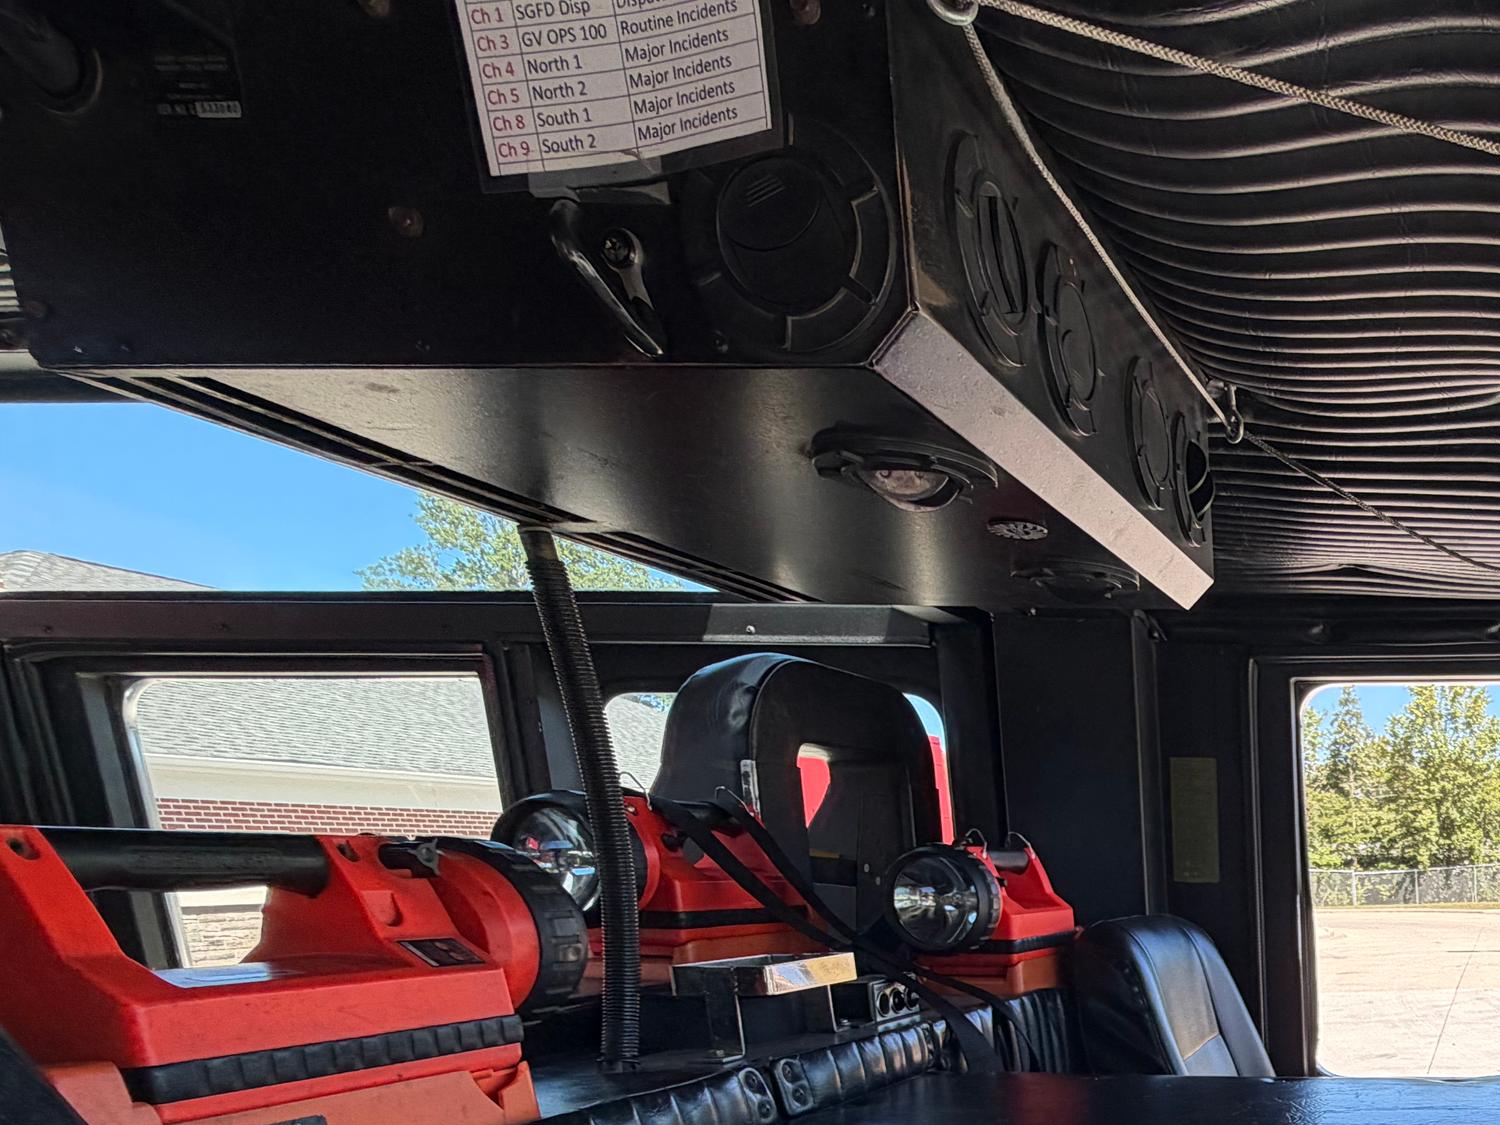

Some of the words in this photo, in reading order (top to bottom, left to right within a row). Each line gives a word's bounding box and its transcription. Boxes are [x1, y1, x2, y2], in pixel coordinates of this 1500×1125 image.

[471, 8, 491, 24] Ch
[495, 7, 503, 23] 1
[515, 2, 555, 20] SGFD
[559, 0, 591, 16] Disp
[477, 35, 497, 52] Ch
[500, 35, 510, 50] 3
[522, 30, 542, 47] GV
[547, 27, 577, 45] OPS
[580, 24, 607, 41] 100
[620, 15, 674, 36] Routine
[676, 0, 738, 25] Incidents
[482, 63, 502, 79] Ch
[506, 62, 515, 76] 4
[527, 56, 570, 75] North
[574, 54, 583, 70] 1
[624, 45, 665, 64] Major
[669, 29, 729, 54] Incidents
[487, 89, 509, 105] Ch
[511, 88, 520, 103] 5
[532, 83, 576, 102] North
[578, 81, 588, 96] 2
[629, 70, 670, 90] Major
[673, 54, 733, 80] Incidents
[492, 115, 515, 132] Ch
[516, 115, 526, 129] 8
[536, 110, 580, 128] South
[584, 108, 592, 122] 1
[633, 96, 674, 116] Major
[676, 81, 736, 106] Incidents
[497, 141, 519, 158] Ch
[520, 141, 530, 156] 9
[542, 136, 585, 154] South
[587, 134, 597, 149] 2
[637, 123, 676, 142] Major
[679, 107, 738, 132] Incidents
